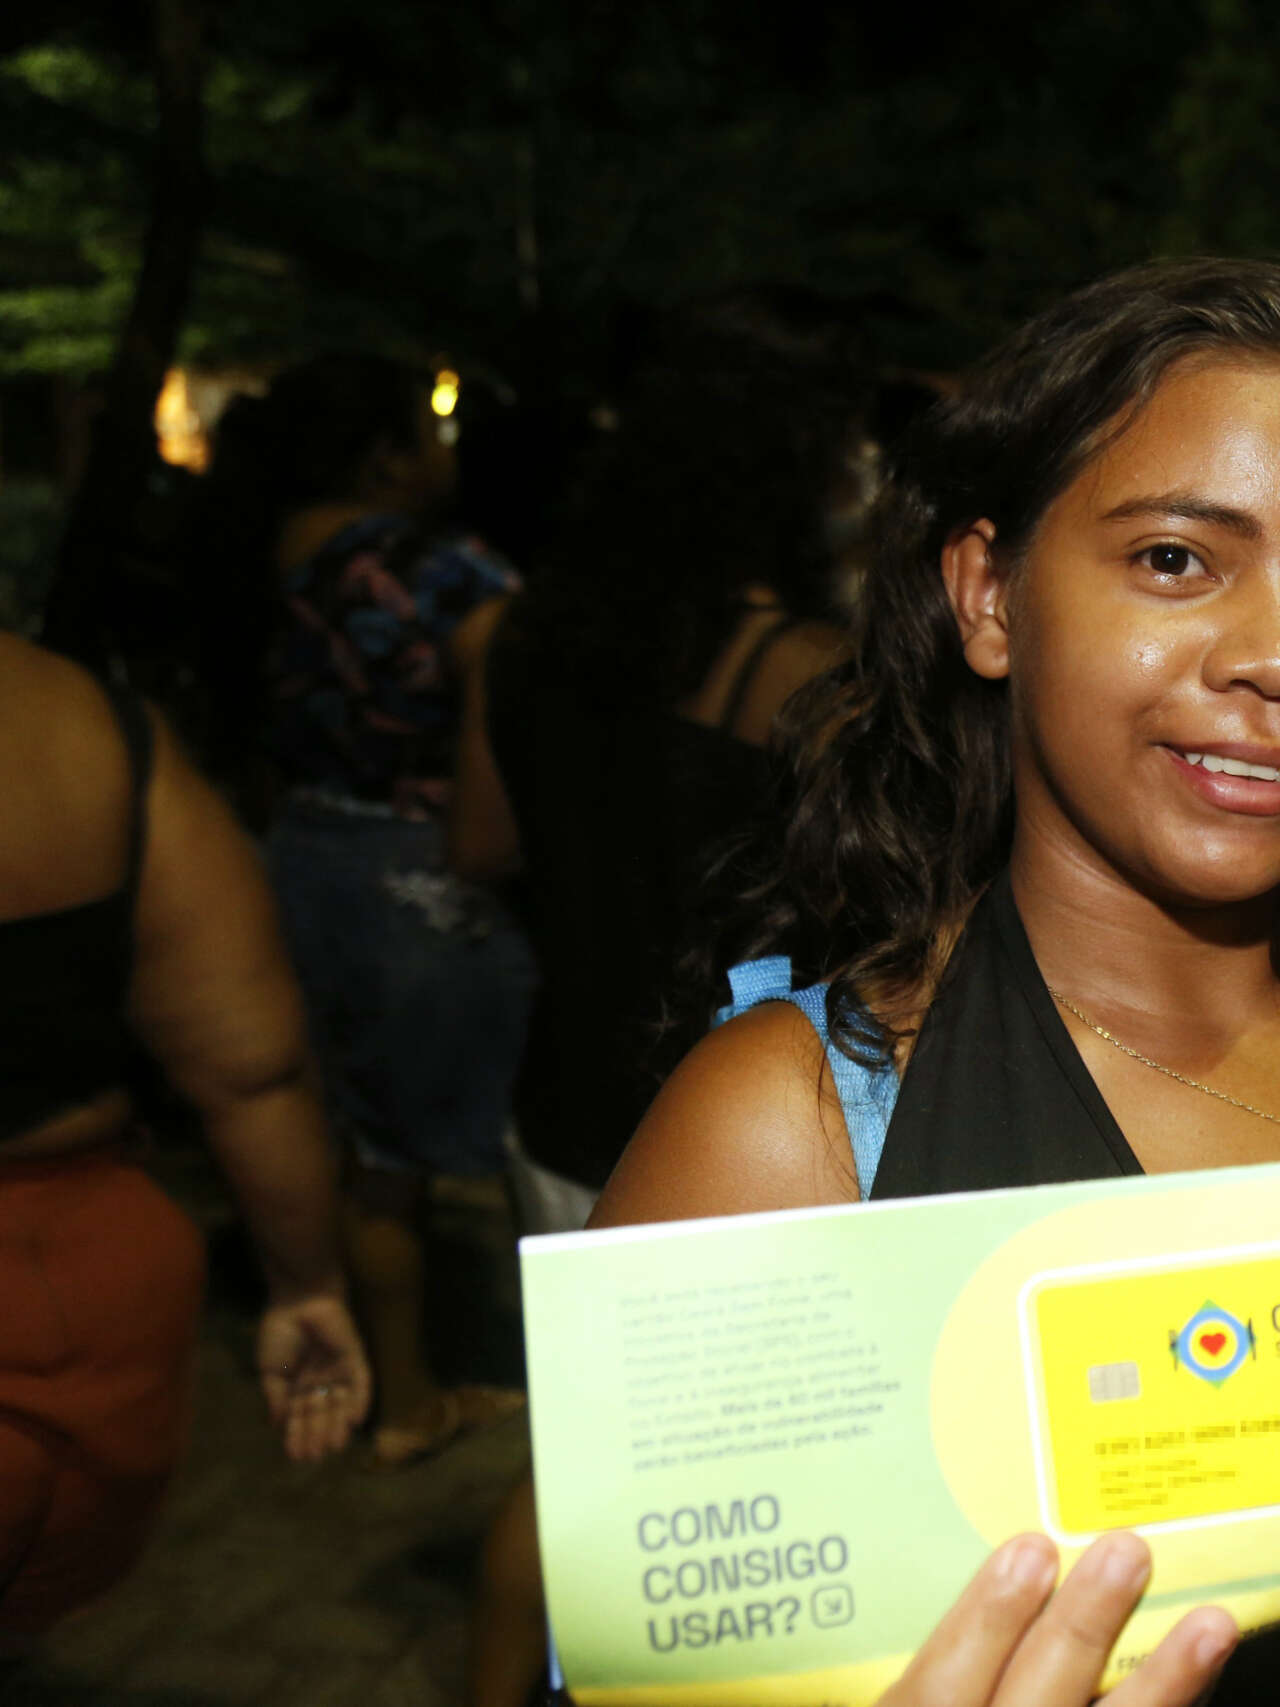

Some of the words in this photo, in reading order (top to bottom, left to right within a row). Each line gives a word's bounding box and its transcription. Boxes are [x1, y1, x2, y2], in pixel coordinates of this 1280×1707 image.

[636, 1493, 781, 1553] COMO
[641, 1534, 849, 1605] CONSIGO
[646, 1596, 801, 1654] USAR?
